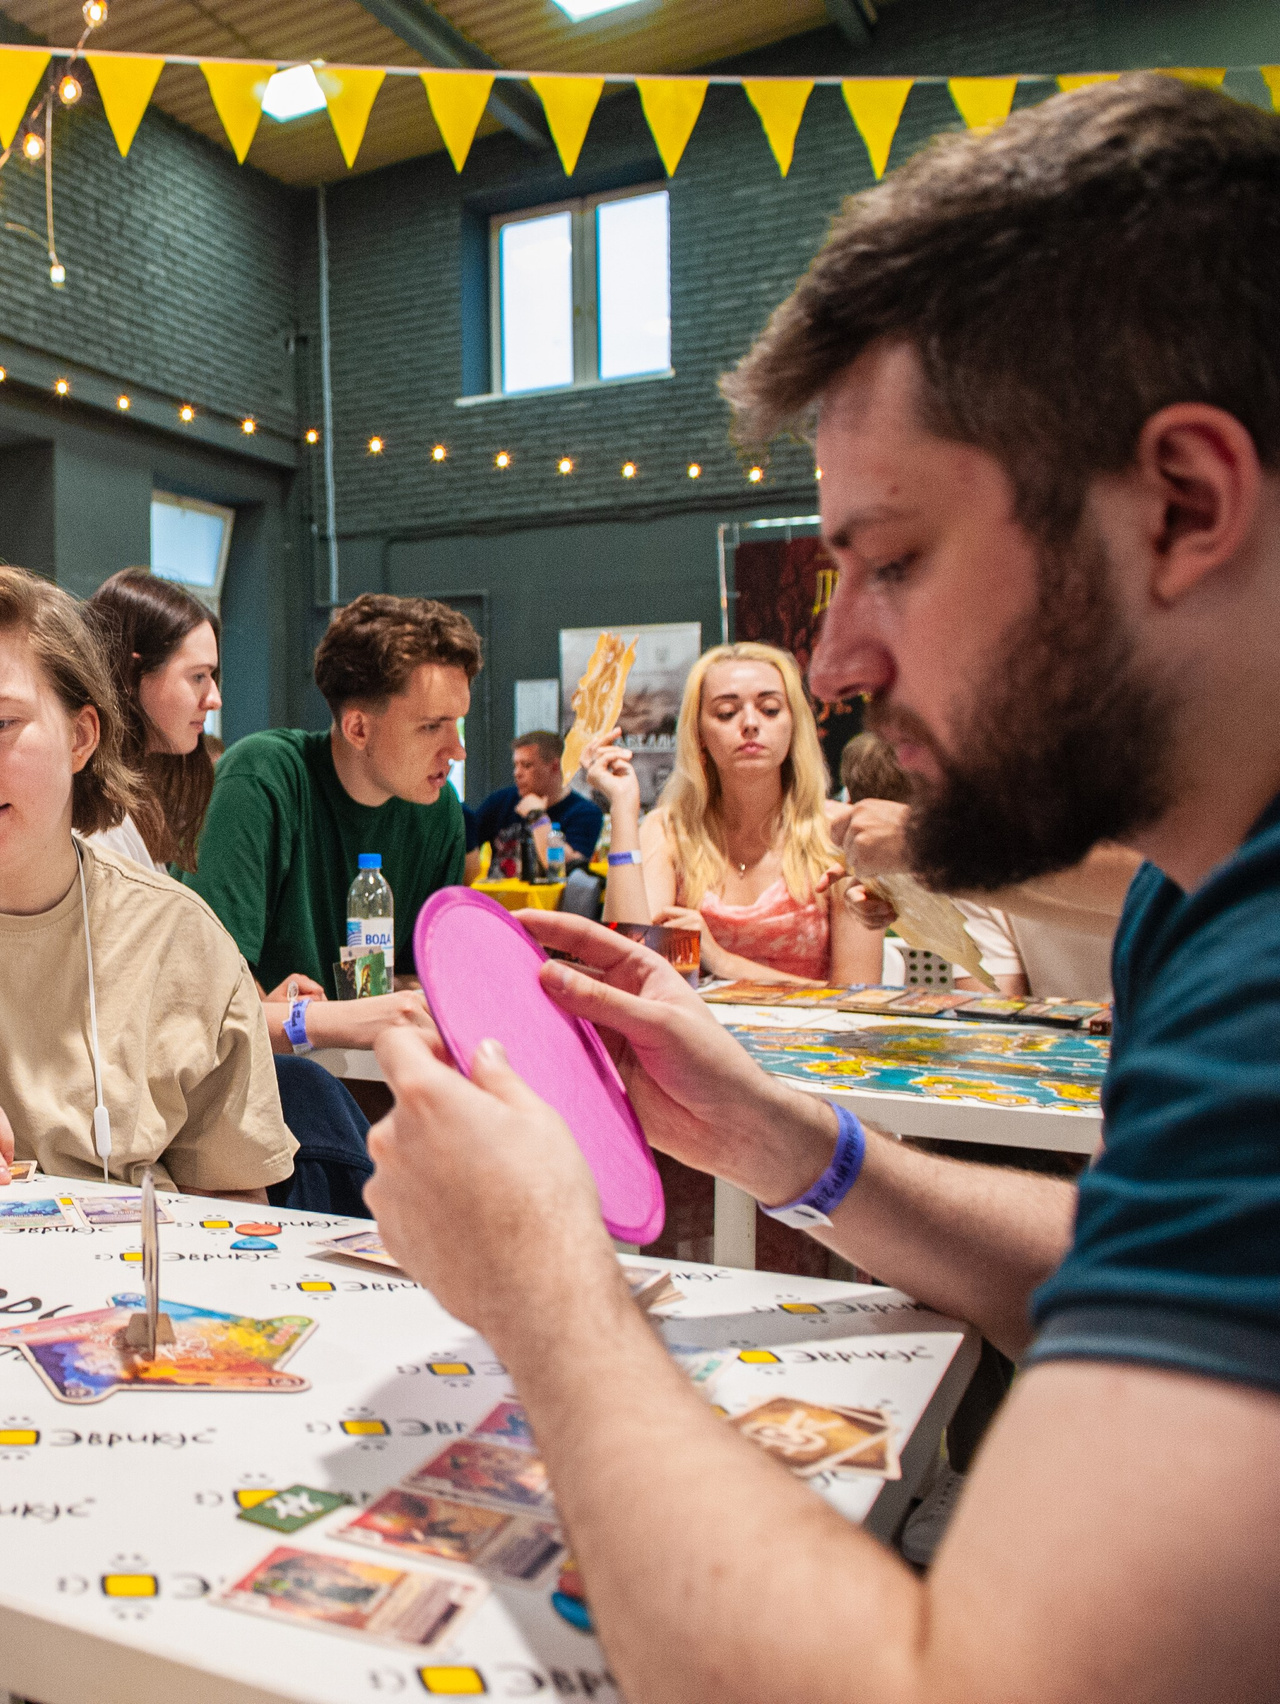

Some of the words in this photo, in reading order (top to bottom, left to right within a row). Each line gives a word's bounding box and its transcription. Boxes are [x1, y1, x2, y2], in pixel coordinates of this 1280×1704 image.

[365, 933, 391, 945] ВОДА
[163, 1251, 280, 1264] Эврикус
[342, 1281, 420, 1293] Эври
[786, 1349, 934, 1364] Эврикус
[50, 1428, 215, 1448] Эврикус
